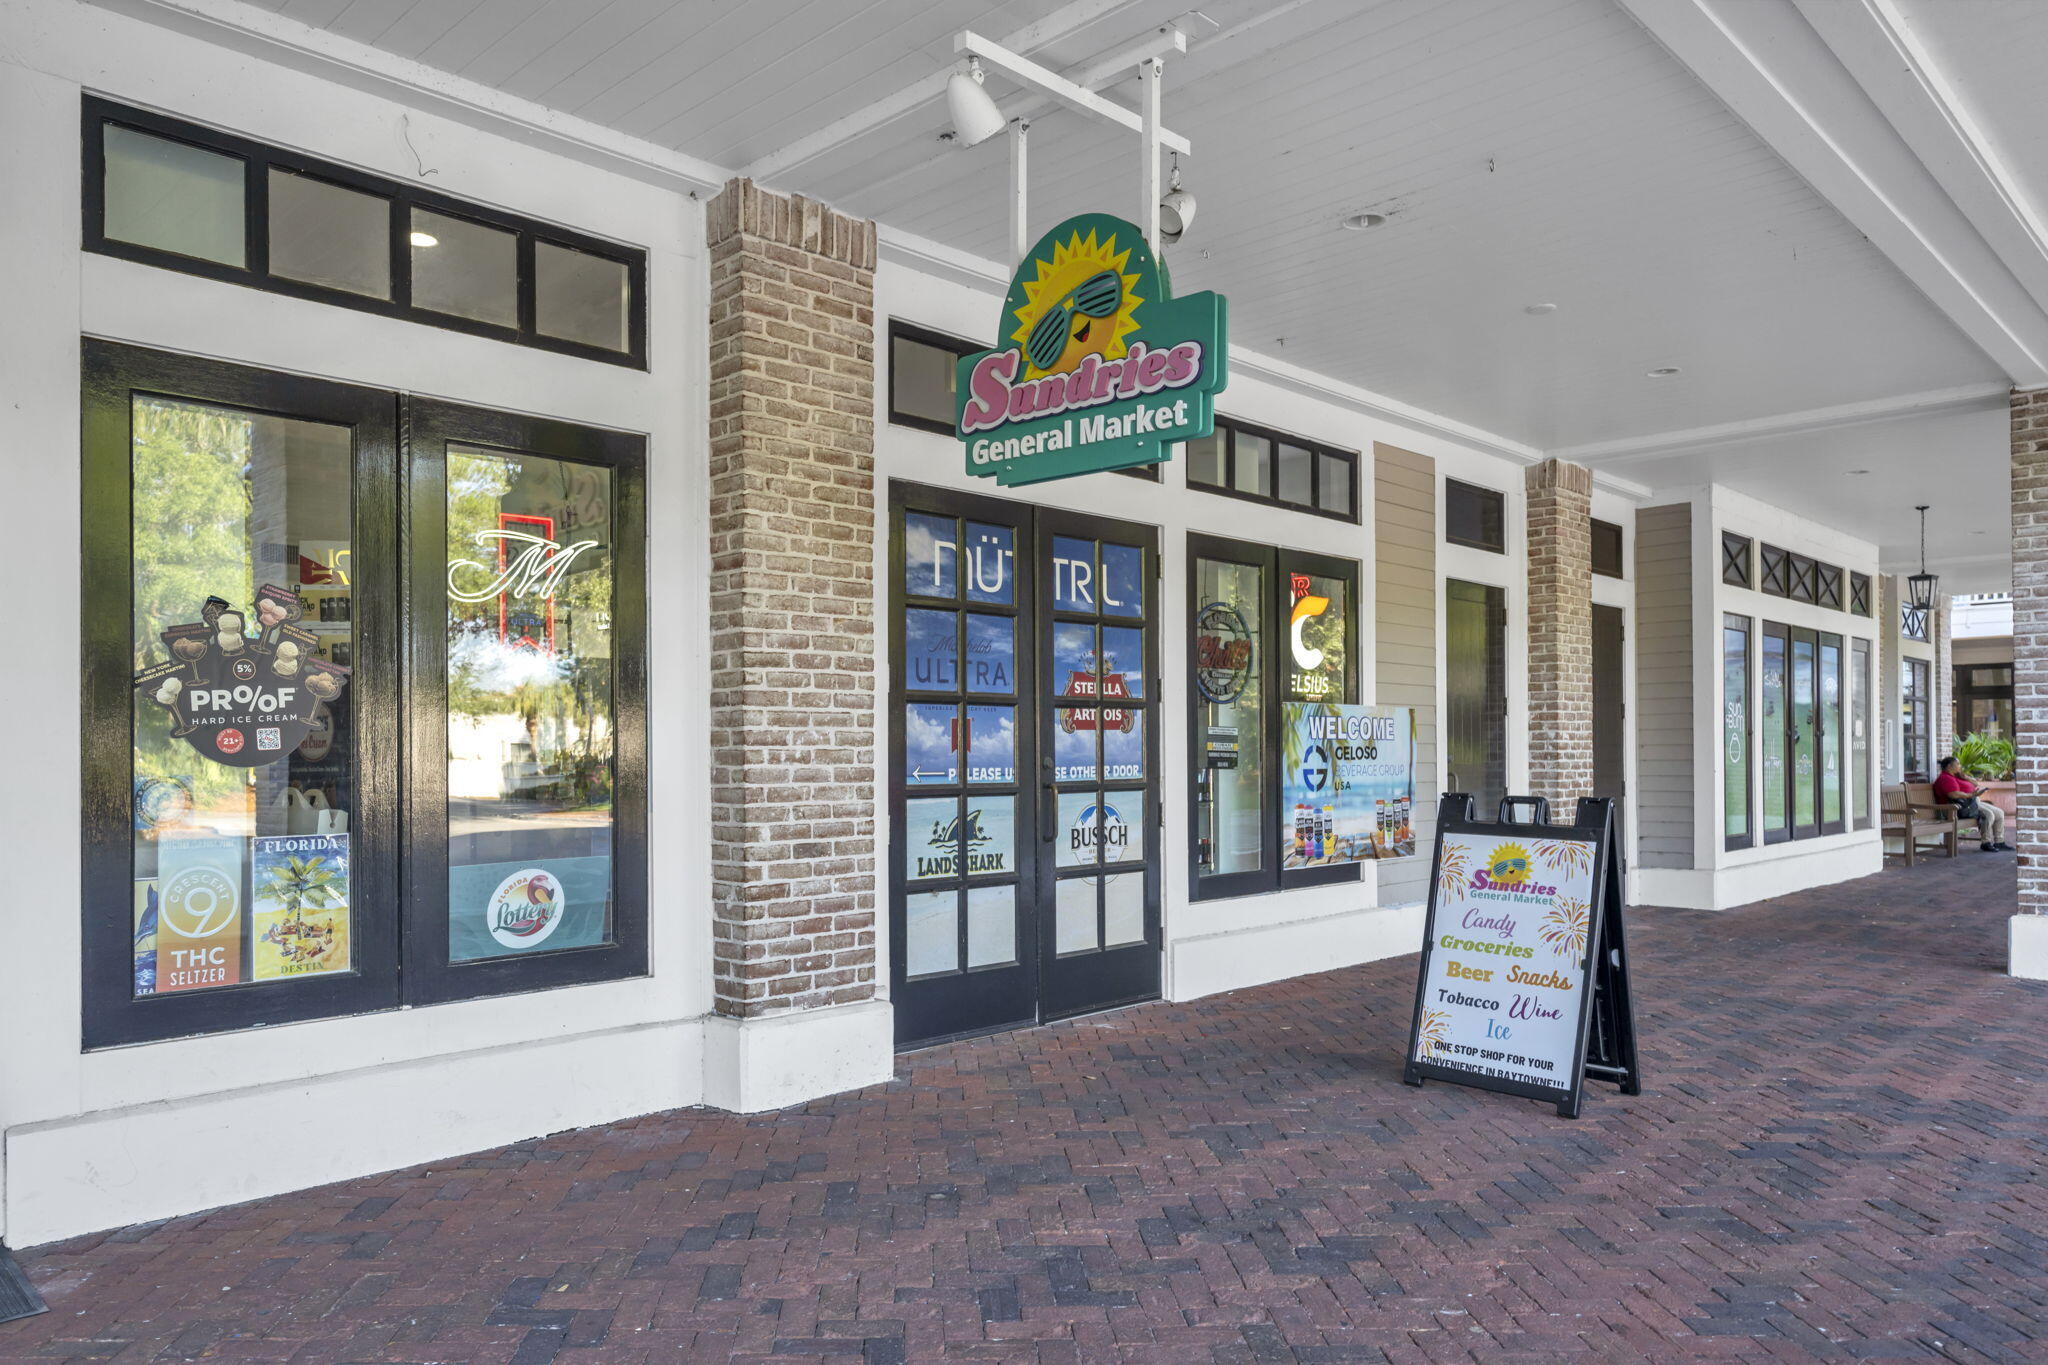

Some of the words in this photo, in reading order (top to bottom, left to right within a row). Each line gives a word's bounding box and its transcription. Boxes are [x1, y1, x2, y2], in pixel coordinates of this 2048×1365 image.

[962, 343, 1200, 432] Sundries
[972, 420, 1072, 466] General
[1080, 399, 1188, 446] Market
[157, 663, 171, 672] YORK
[236, 664, 252, 674] 5%
[915, 657, 1008, 687] ULTRA
[1074, 681, 1122, 695] STELLA
[192, 716, 225, 725] HARD
[232, 715, 251, 723] ICE
[258, 713, 298, 722] CREAM
[1073, 708, 1122, 721] ARTOIS
[1308, 715, 1395, 741] WELCOME
[223, 737, 239, 745] 21+
[1335, 746, 1378, 760] GELOSO
[948, 767, 1002, 781] PLEASE
[1070, 765, 1110, 779] OTHER
[1113, 764, 1139, 777] DOOR
[1335, 764, 1377, 777] BEVERAGE
[1379, 764, 1405, 777] GROUP
[1334, 781, 1352, 791] USA
[264, 838, 339, 853] FLORIDA
[1071, 825, 1128, 849] BUSCH
[917, 852, 1005, 877] LANDSHARK
[170, 874, 230, 904] CRESCENT
[498, 877, 528, 903] FLORIDA
[1470, 869, 1557, 896] Sundries
[1470, 889, 1511, 902] General
[1513, 893, 1554, 906] Market
[184, 887, 219, 938] 9
[493, 901, 558, 932] Lottery
[1462, 907, 1517, 939] Candy
[170, 947, 226, 968] THC
[1440, 935, 1535, 959] Groceries
[170, 967, 226, 986] SELTZER
[280, 961, 326, 974] DESTIN
[1446, 960, 1494, 983] Beer
[1506, 965, 1573, 990] Snacks
[1438, 988, 1500, 1011] Tobacco
[1508, 994, 1564, 1020] Wine
[1485, 1018, 1512, 1040] Ice
[1421, 1055, 1484, 1074] CONVENIENCE
[1485, 1067, 1496, 1077] IN
[1434, 1040, 1453, 1053] ONE
[1454, 1044, 1479, 1057] STOP
[1480, 1049, 1505, 1061] SHOP
[1507, 1054, 1526, 1067] FOR
[1528, 1058, 1554, 1071] YOUR
